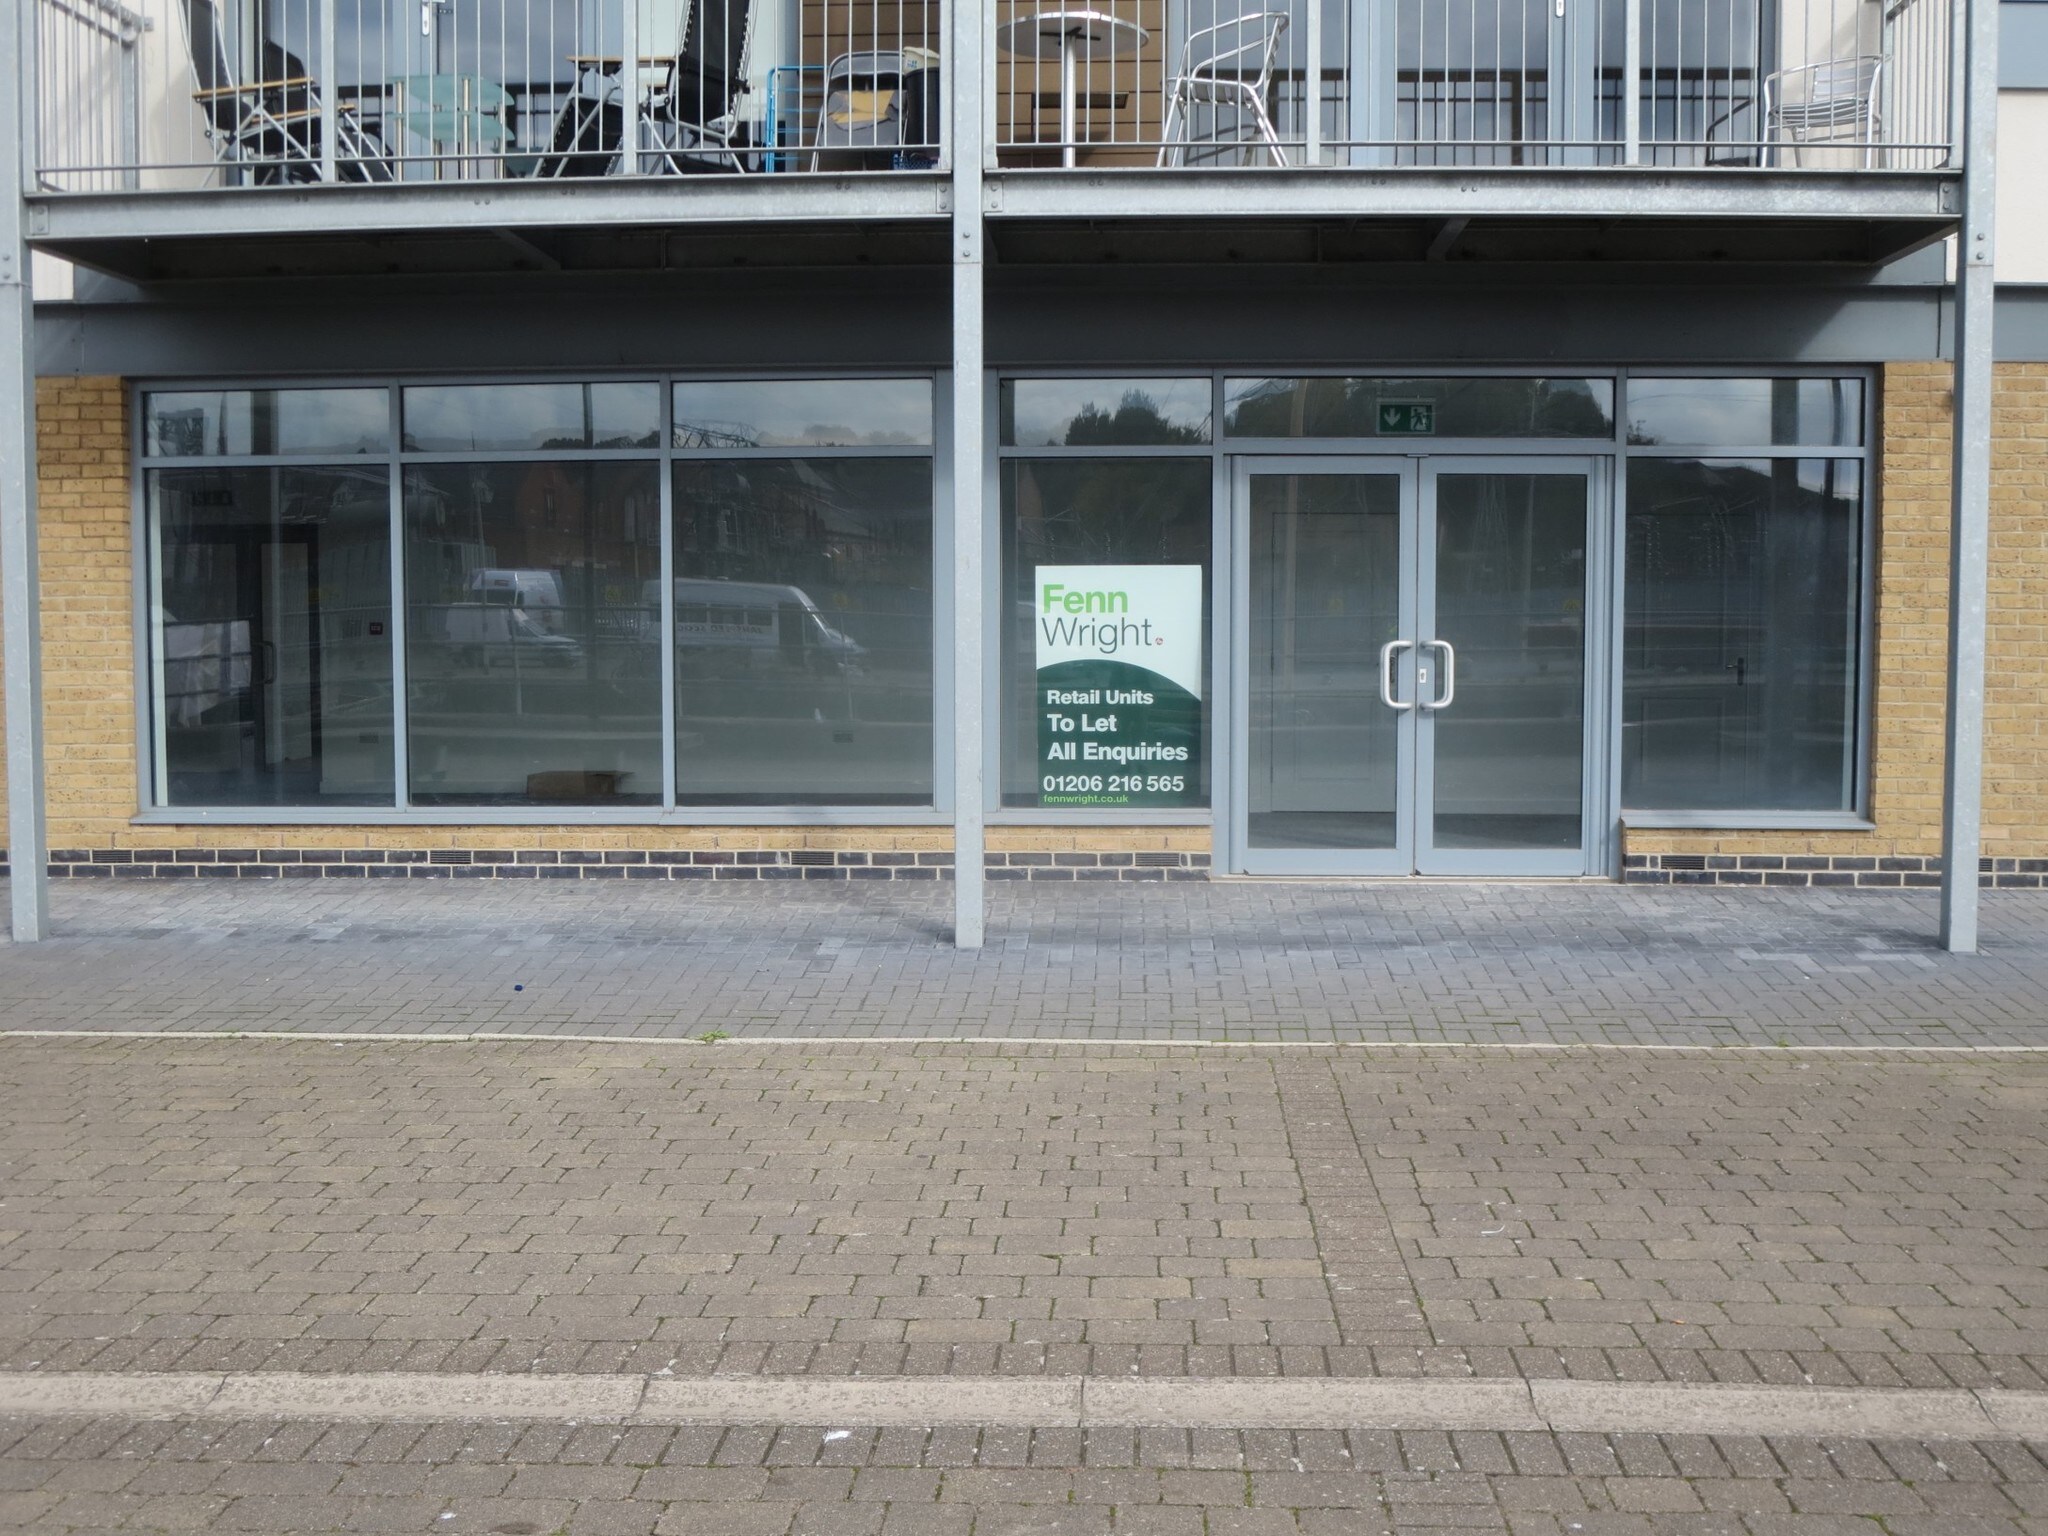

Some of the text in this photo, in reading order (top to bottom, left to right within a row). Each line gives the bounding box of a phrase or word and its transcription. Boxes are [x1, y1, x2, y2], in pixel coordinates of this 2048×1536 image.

[1043, 584, 1128, 614] Fenn
[1047, 689, 1154, 705] Retail Units
[1047, 713, 1117, 732] To Let
[1047, 741, 1189, 765] All Enquiries
[1043, 775, 1185, 792] 01206 216 565
[1043, 794, 1129, 805] fennwright.co.uk
